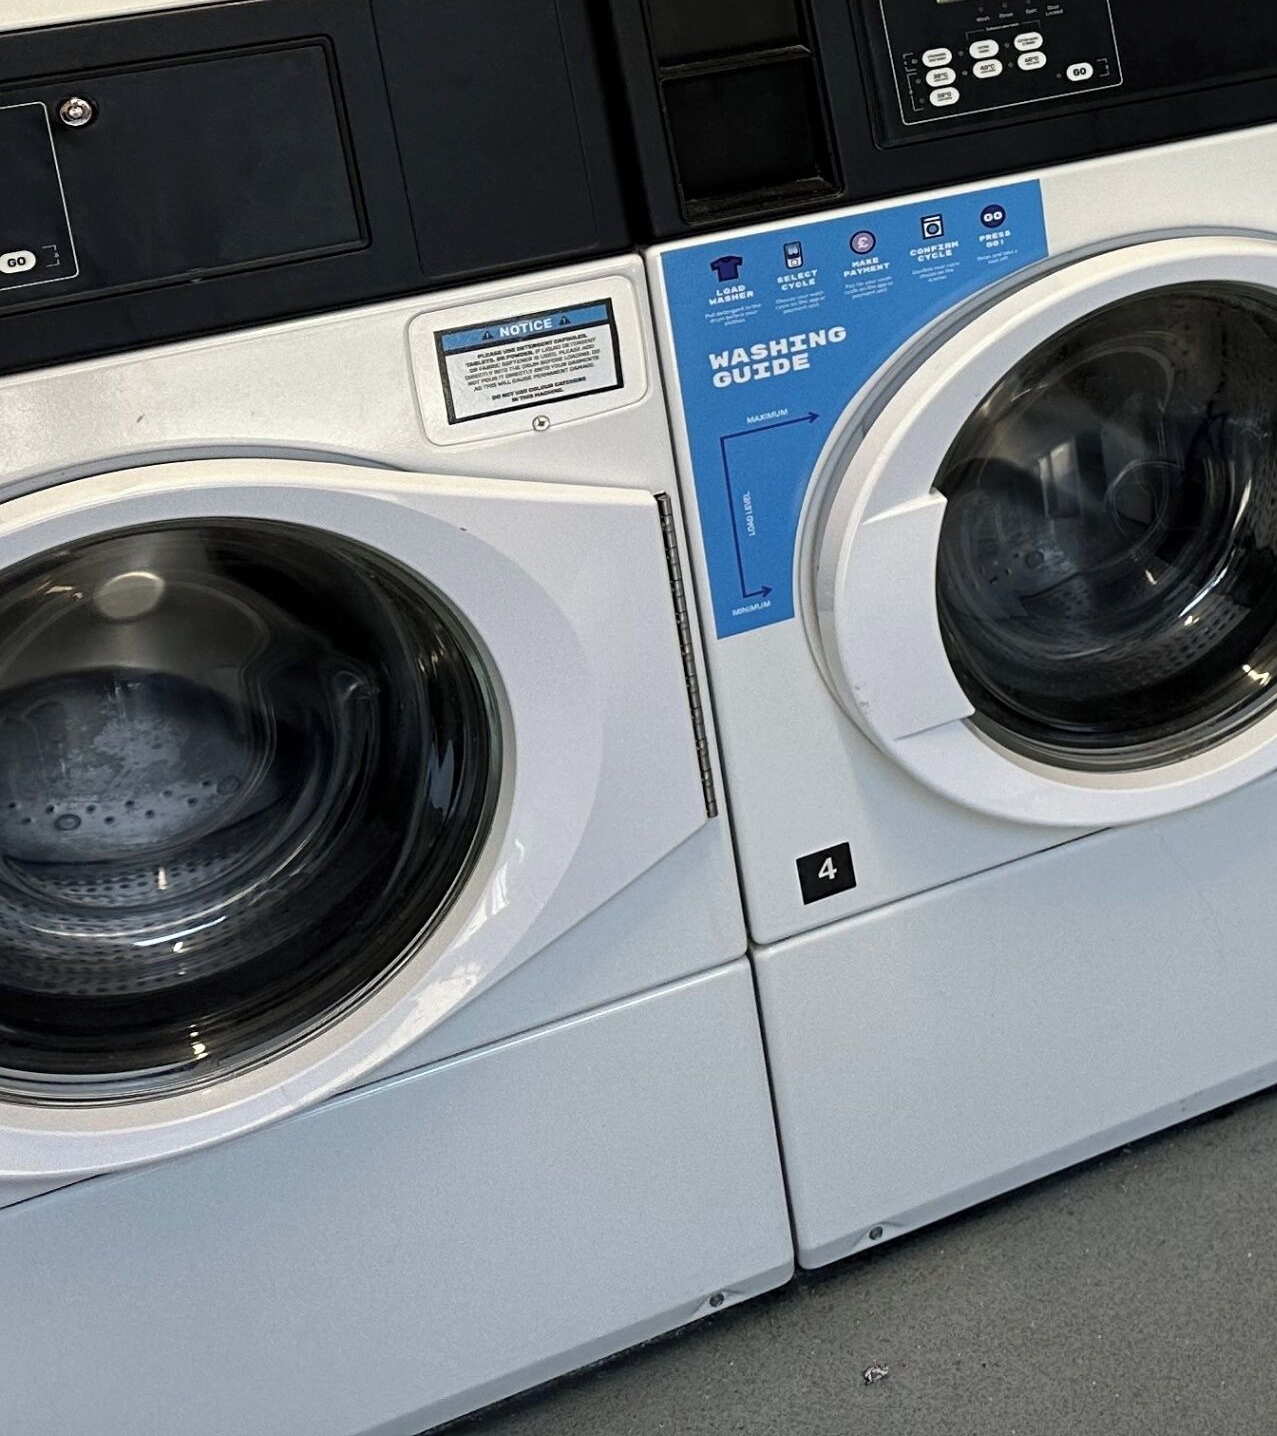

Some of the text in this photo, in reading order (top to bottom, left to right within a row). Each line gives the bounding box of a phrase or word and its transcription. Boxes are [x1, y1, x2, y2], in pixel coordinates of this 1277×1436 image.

[1072, 66, 1087, 78] GO
[983, 211, 1003, 222] GO
[979, 230, 1011, 242] PRESS
[910, 240, 959, 257] CONFIRM
[917, 249, 953, 262] CYCLE
[7, 256, 26, 268] GO
[851, 257, 879, 268] MAKE
[777, 269, 818, 283] SELECT
[843, 262, 890, 277] PAYMENT
[716, 285, 746, 297] LOAD
[781, 278, 816, 291] CYCLE
[708, 290, 755, 306] WASHER
[500, 318, 552, 338] NOTICE
[708, 326, 847, 371] WASHING
[712, 355, 811, 389] GUIDE
[746, 408, 789, 424] MAXIMUM
[732, 600, 771, 617] MINIMUM
[819, 857, 837, 879] 4
